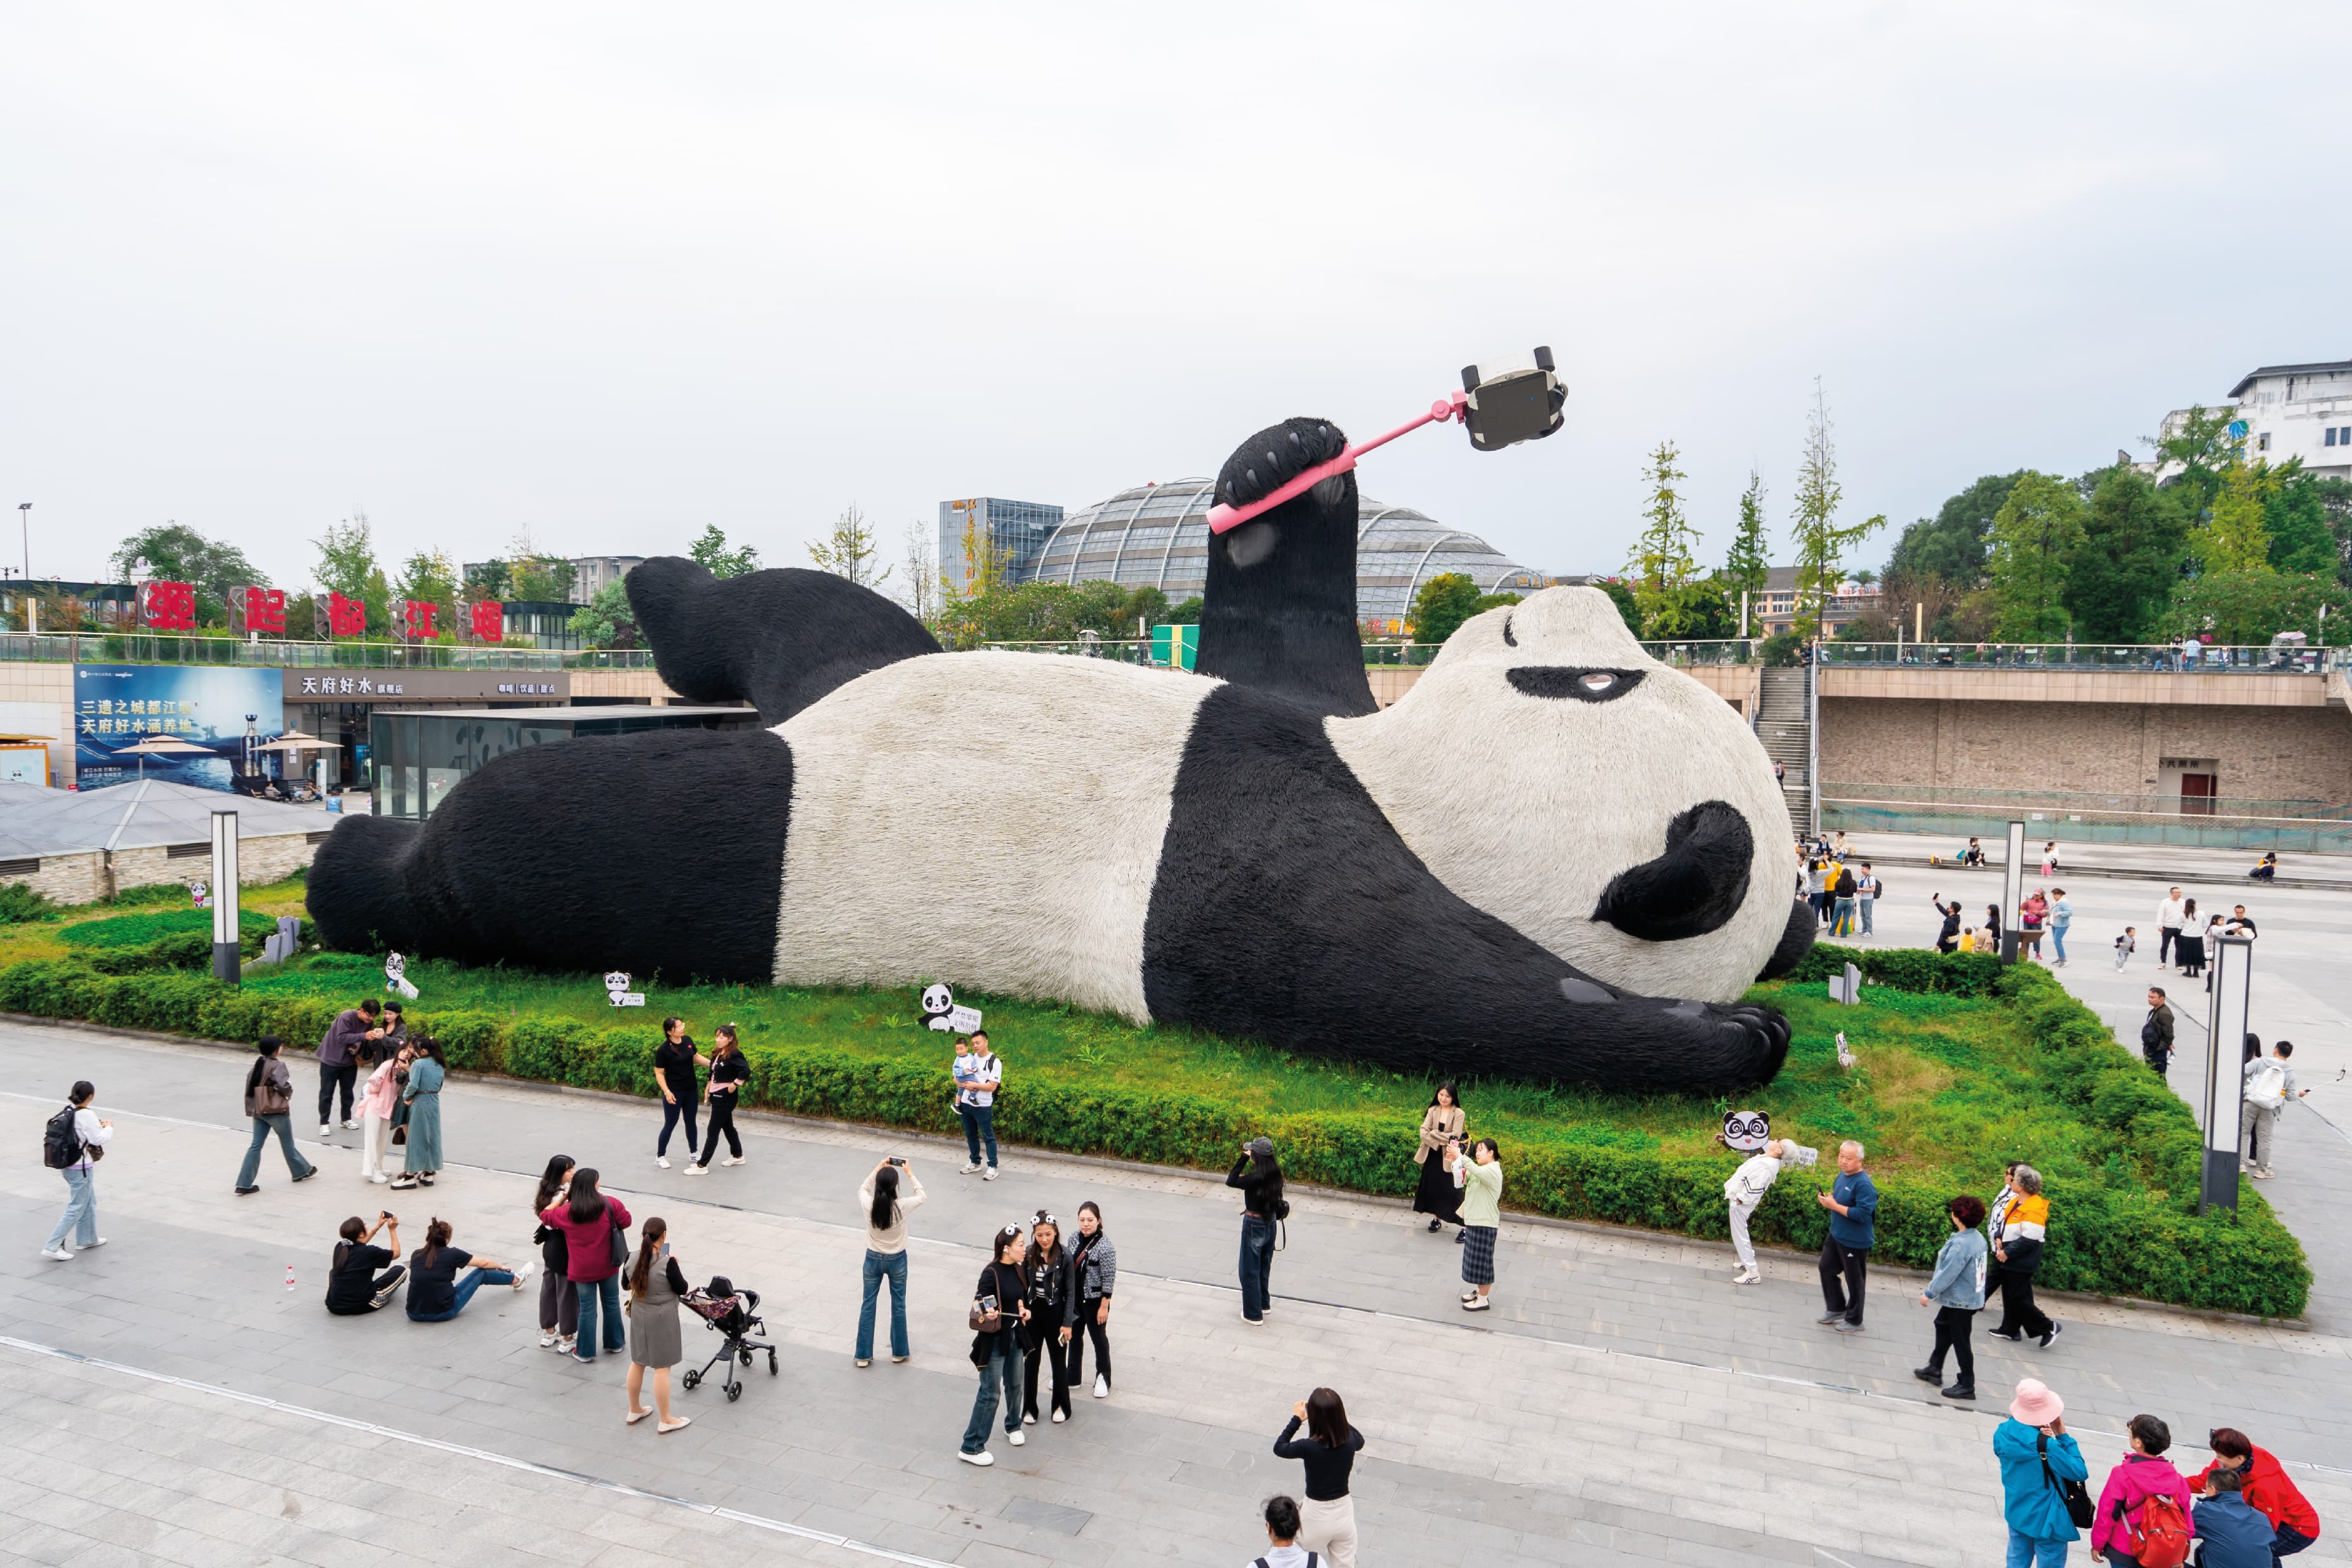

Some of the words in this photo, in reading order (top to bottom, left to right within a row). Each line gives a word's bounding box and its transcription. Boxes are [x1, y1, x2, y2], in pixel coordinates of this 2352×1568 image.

[148, 581, 503, 642] 源起都江堰
[302, 677, 372, 694] 天府好水
[376, 684, 404, 694] 旗舰店
[498, 684, 513, 693] 咖啡
[520, 684, 534, 693] 饮品
[540, 684, 555, 693] 甜点
[81, 700, 191, 715] 三遗之城都江堰
[81, 718, 192, 734] 天府好水涵养地
